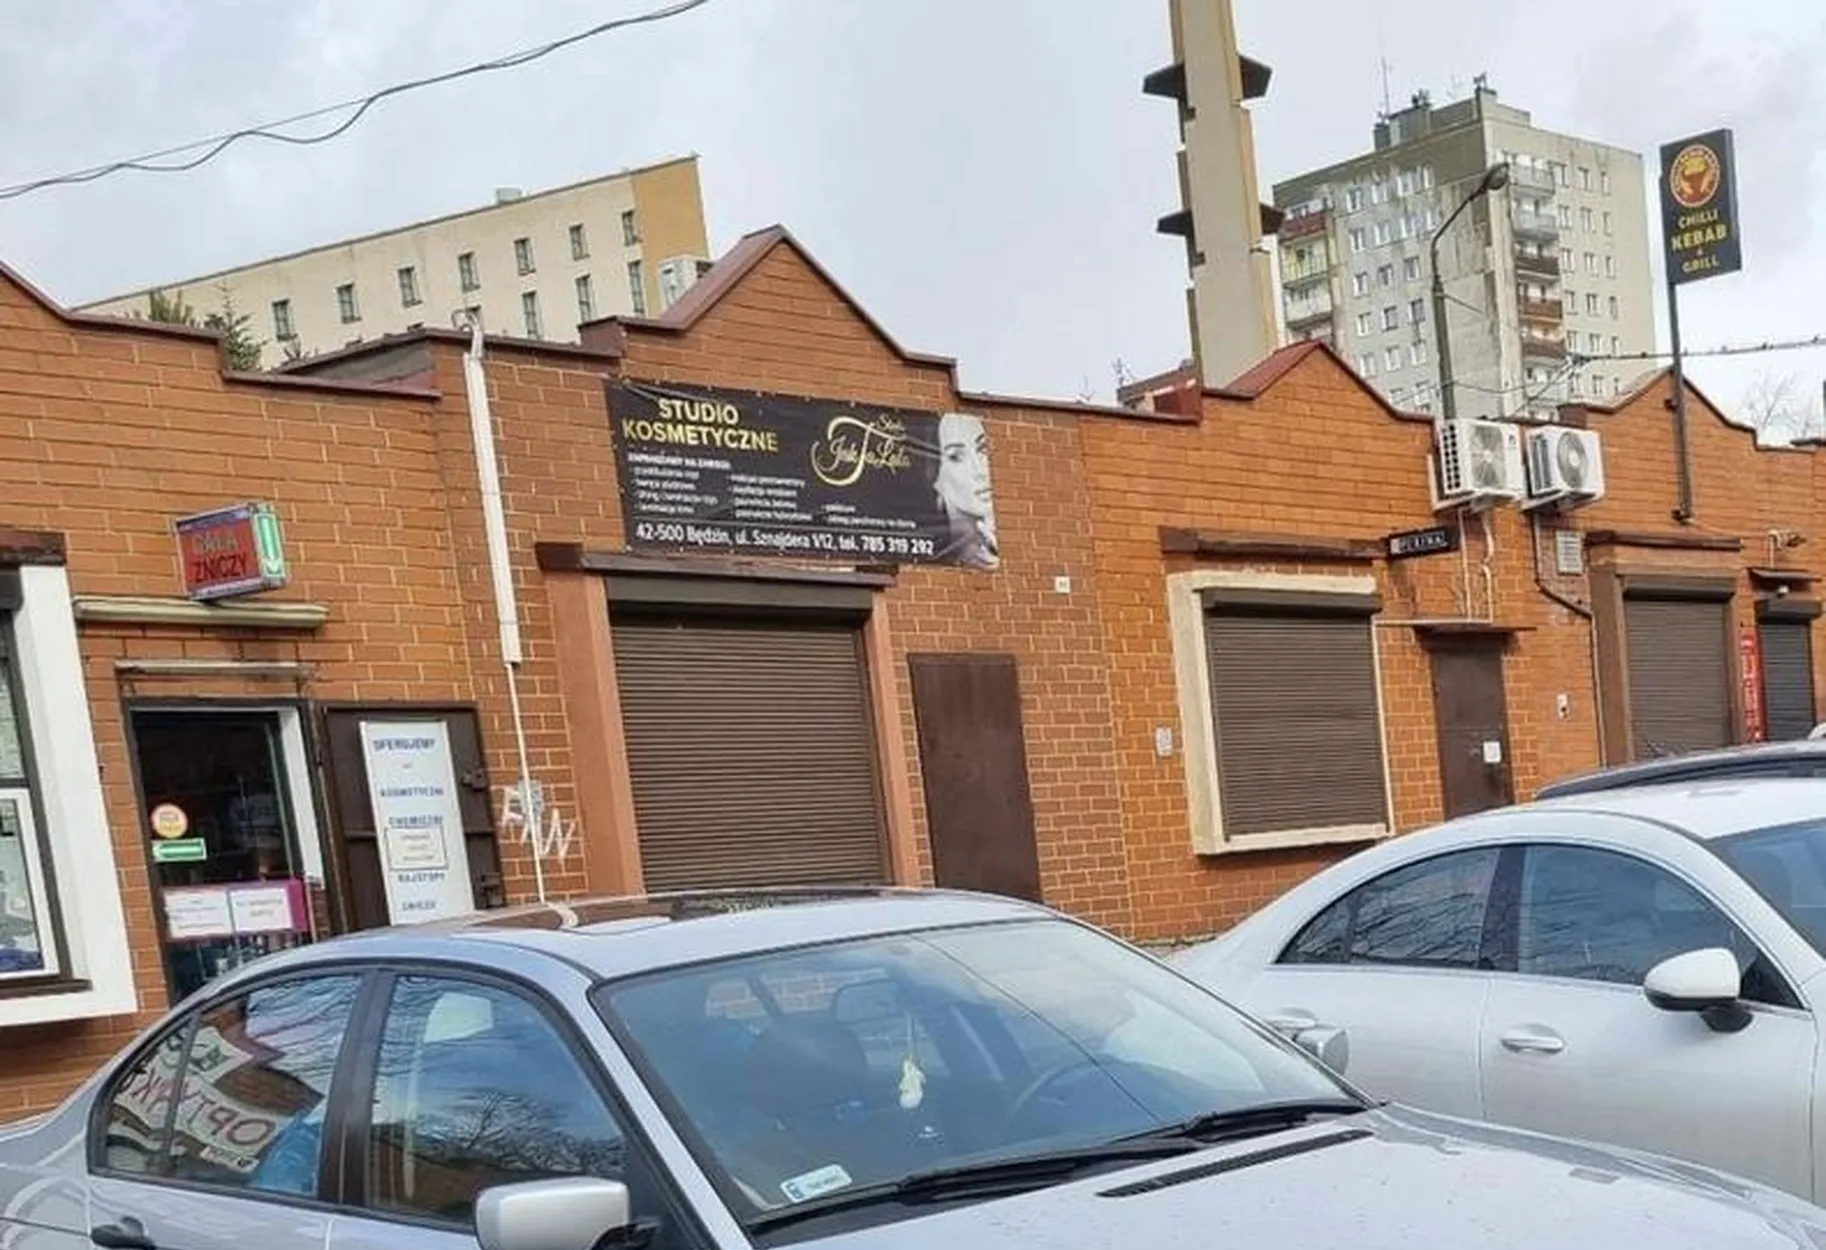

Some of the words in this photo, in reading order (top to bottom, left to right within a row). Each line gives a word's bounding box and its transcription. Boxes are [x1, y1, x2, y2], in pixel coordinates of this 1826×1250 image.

[1678, 209, 1719, 228] CHILLI
[1671, 224, 1727, 250] KEBAB
[1682, 255, 1719, 273] GRILL
[658, 399, 739, 425] STUDIO
[622, 419, 779, 452] KOSMETYCZNE
[636, 522, 684, 542] 42-500
[190, 552, 247, 583] ZNICZY
